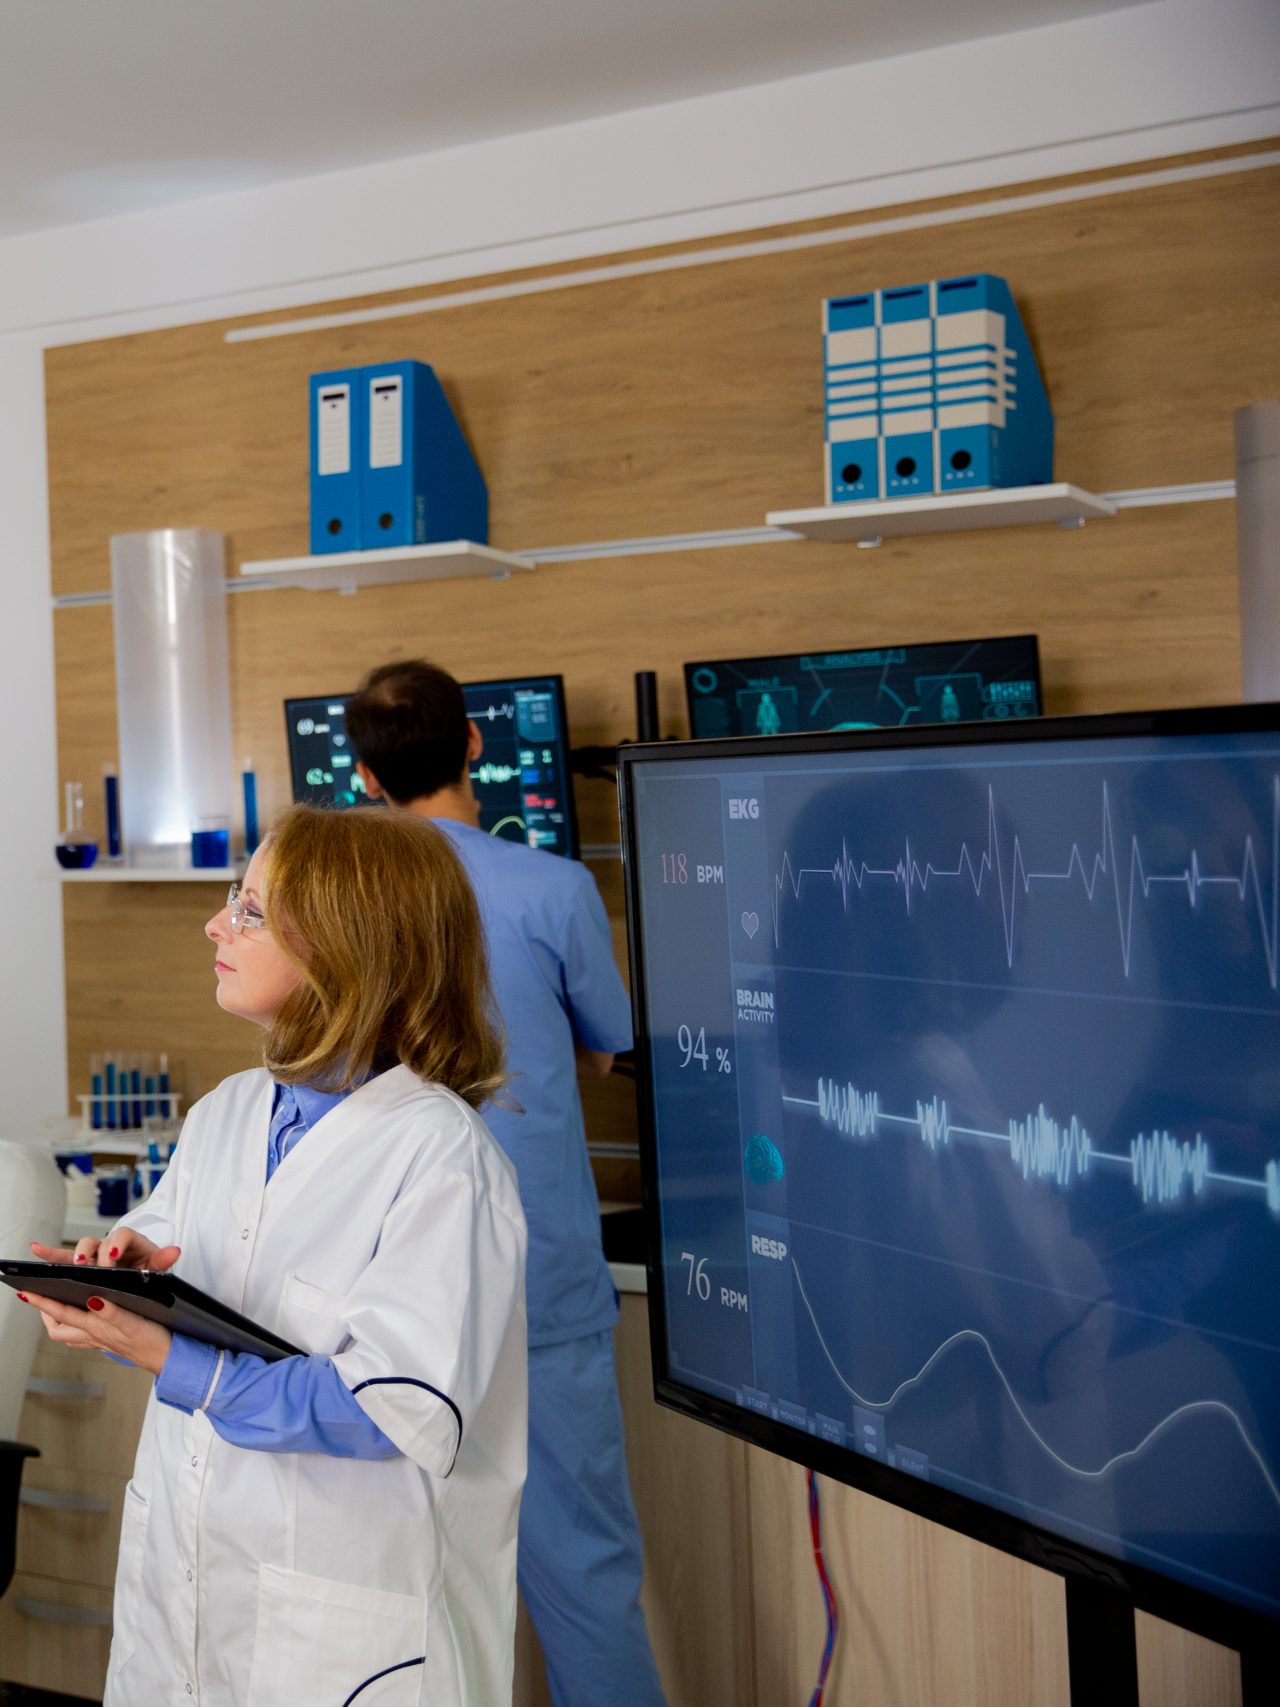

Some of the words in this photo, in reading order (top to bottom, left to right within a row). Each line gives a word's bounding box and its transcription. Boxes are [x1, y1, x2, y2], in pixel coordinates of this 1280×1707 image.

[728, 798, 760, 819] EKG
[660, 852, 688, 884] 118
[696, 865, 724, 884] BPM
[736, 988, 775, 1009] BRAIN
[737, 1007, 775, 1024] ACTIVITY
[678, 1024, 709, 1071] 94
[715, 1047, 732, 1074] %
[751, 1234, 788, 1261] RESP
[681, 1251, 711, 1301] 76
[720, 1286, 748, 1313] RPM
[778, 1408, 808, 1427] MONITOR
